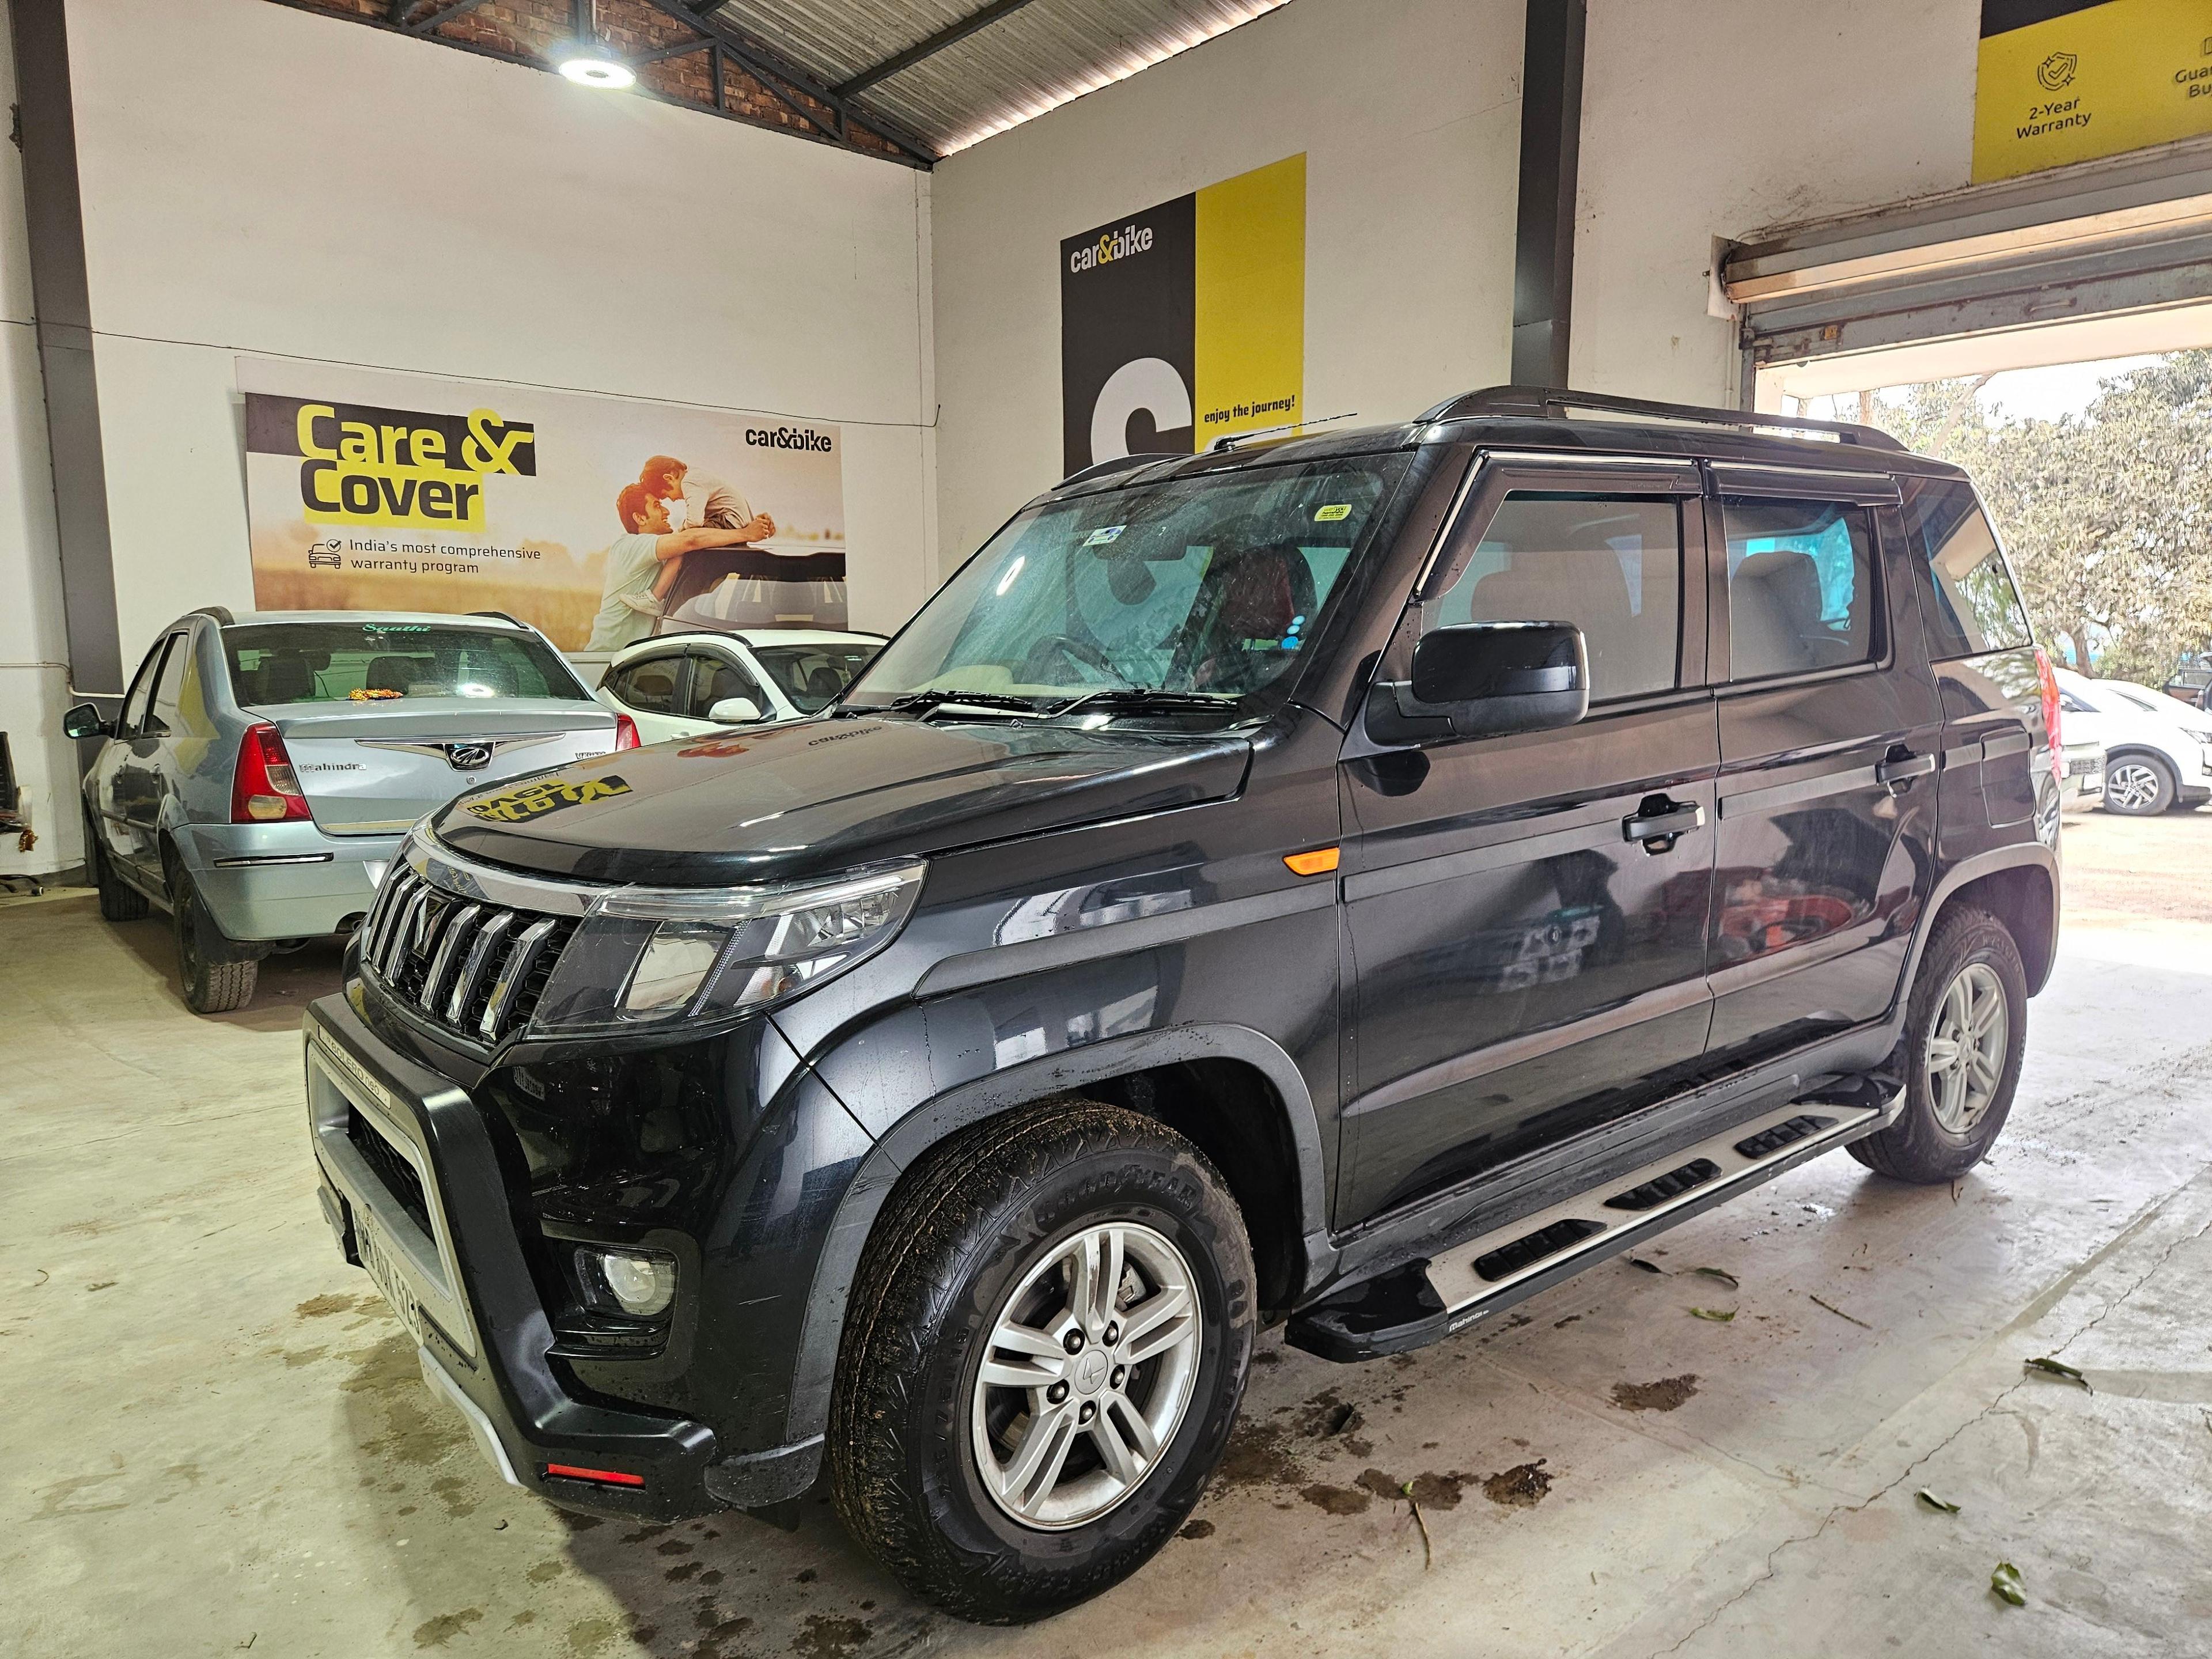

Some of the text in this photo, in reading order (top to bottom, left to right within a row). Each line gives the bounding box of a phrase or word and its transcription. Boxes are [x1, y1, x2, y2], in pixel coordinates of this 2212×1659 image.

[2189, 84, 2212, 97] Bu
[2029, 98, 2081, 120] 2-Year
[2017, 113, 2092, 139] Warranty
[1070, 225, 1153, 272] car&bike
[1204, 395, 1295, 424] enjoy the journey!
[297, 404, 535, 475] Care &
[745, 427, 832, 452] car&bike
[301, 459, 478, 520] Cover
[350, 539, 541, 560] India's most comprehensive
[351, 559, 479, 574] warranty program
[331, 1041, 364, 1081] BOLERO
